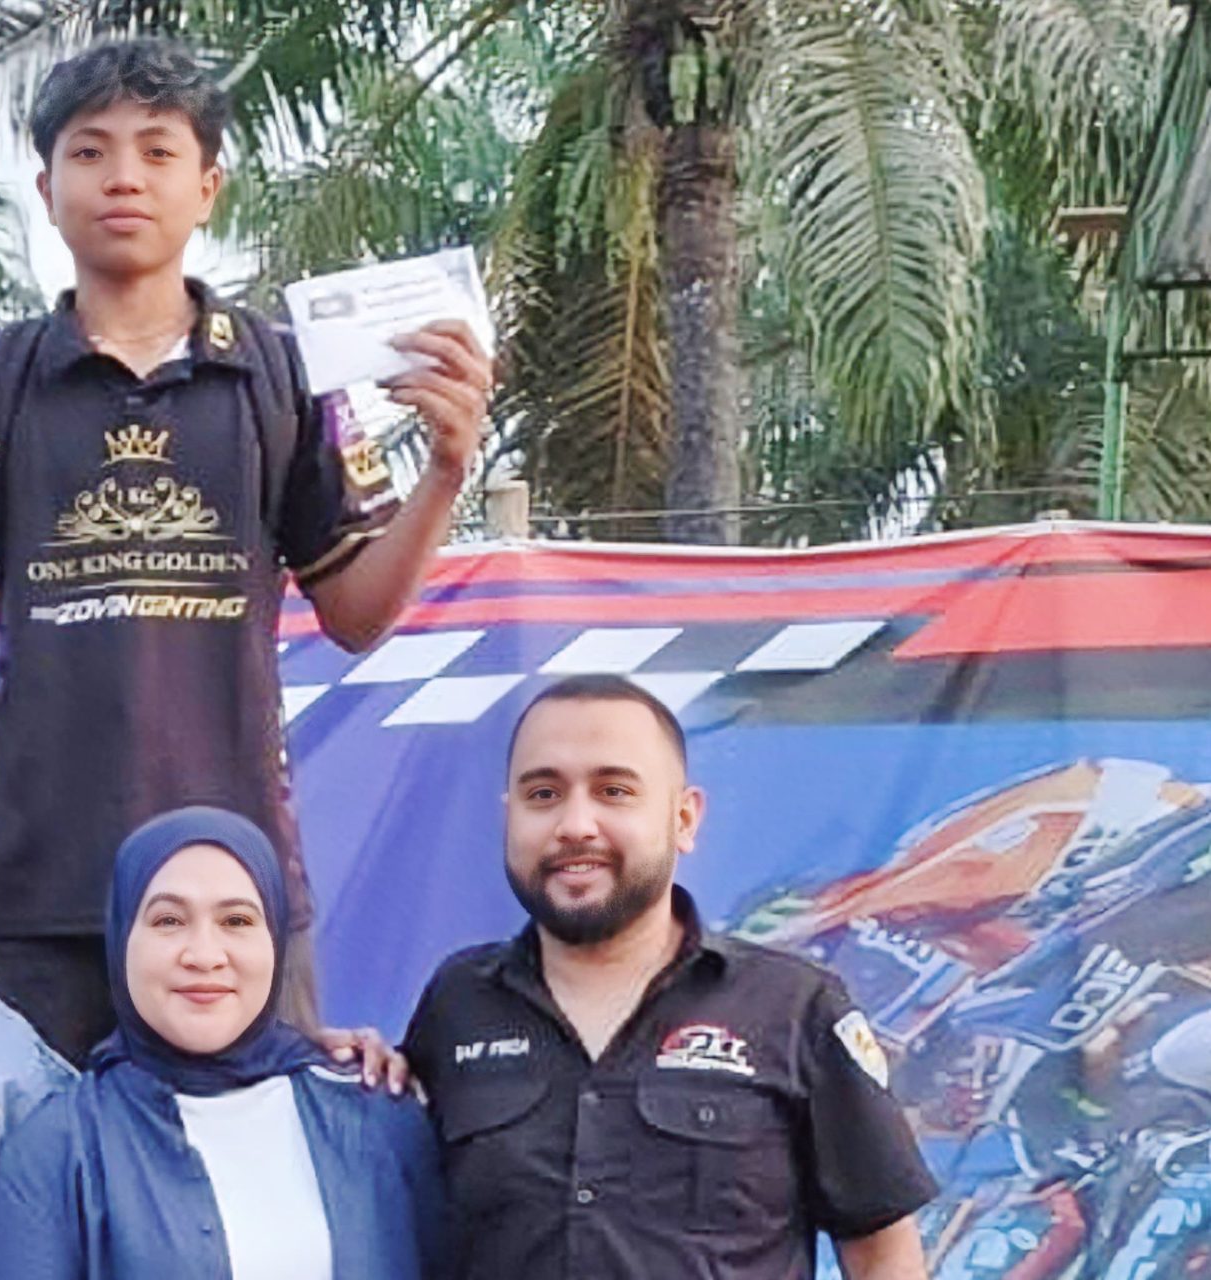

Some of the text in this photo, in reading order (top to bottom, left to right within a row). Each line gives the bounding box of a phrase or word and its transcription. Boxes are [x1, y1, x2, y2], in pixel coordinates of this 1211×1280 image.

[27, 551, 250, 581] ONE KING GOLDEN
